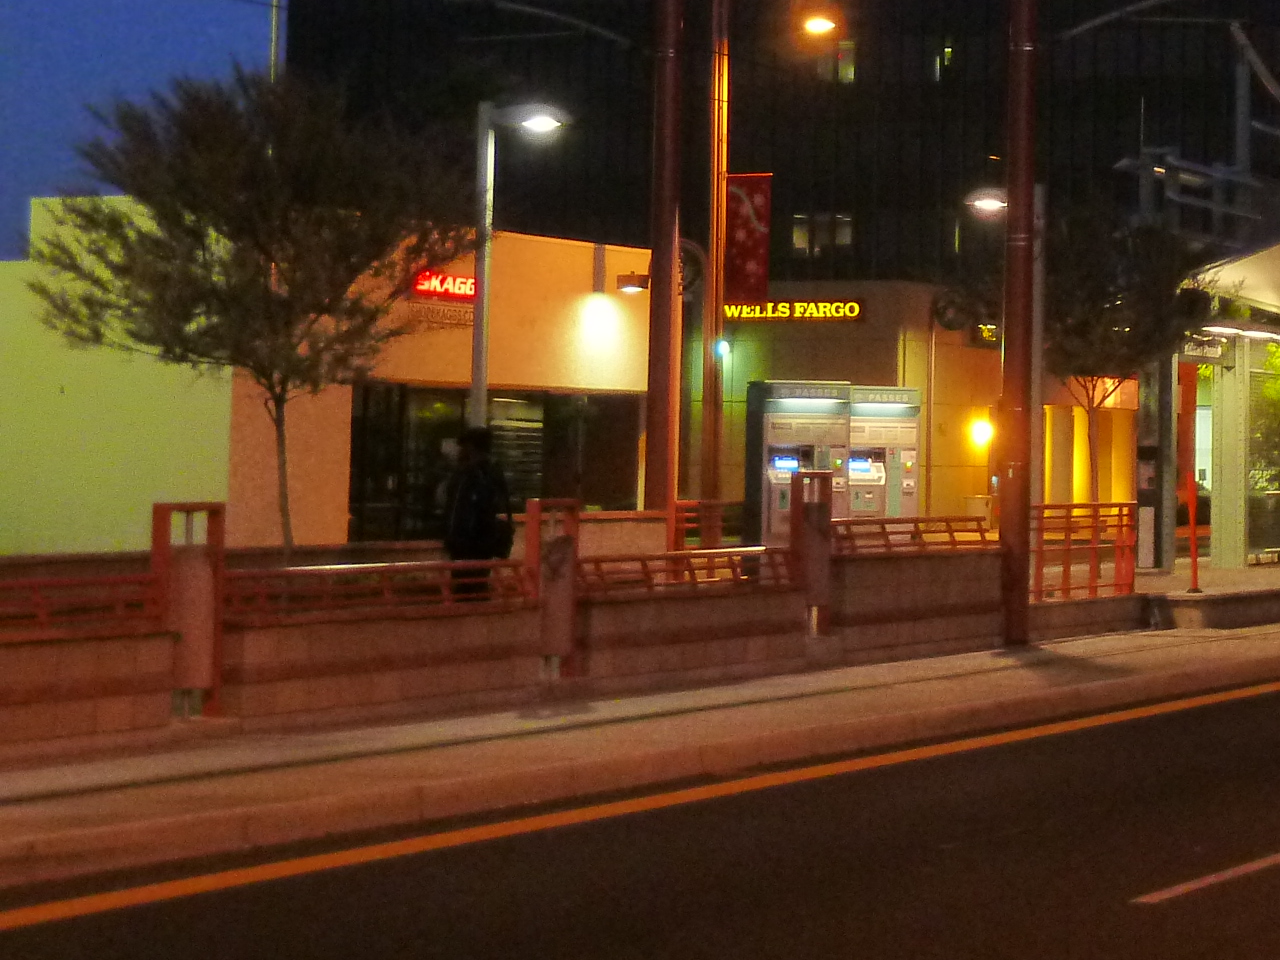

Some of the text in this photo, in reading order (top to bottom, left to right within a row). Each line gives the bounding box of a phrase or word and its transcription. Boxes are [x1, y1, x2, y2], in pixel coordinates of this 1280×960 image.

[416, 272, 475, 295] SKAGG
[723, 302, 860, 318] WELLS FARGO
[868, 393, 909, 402] PASSES
